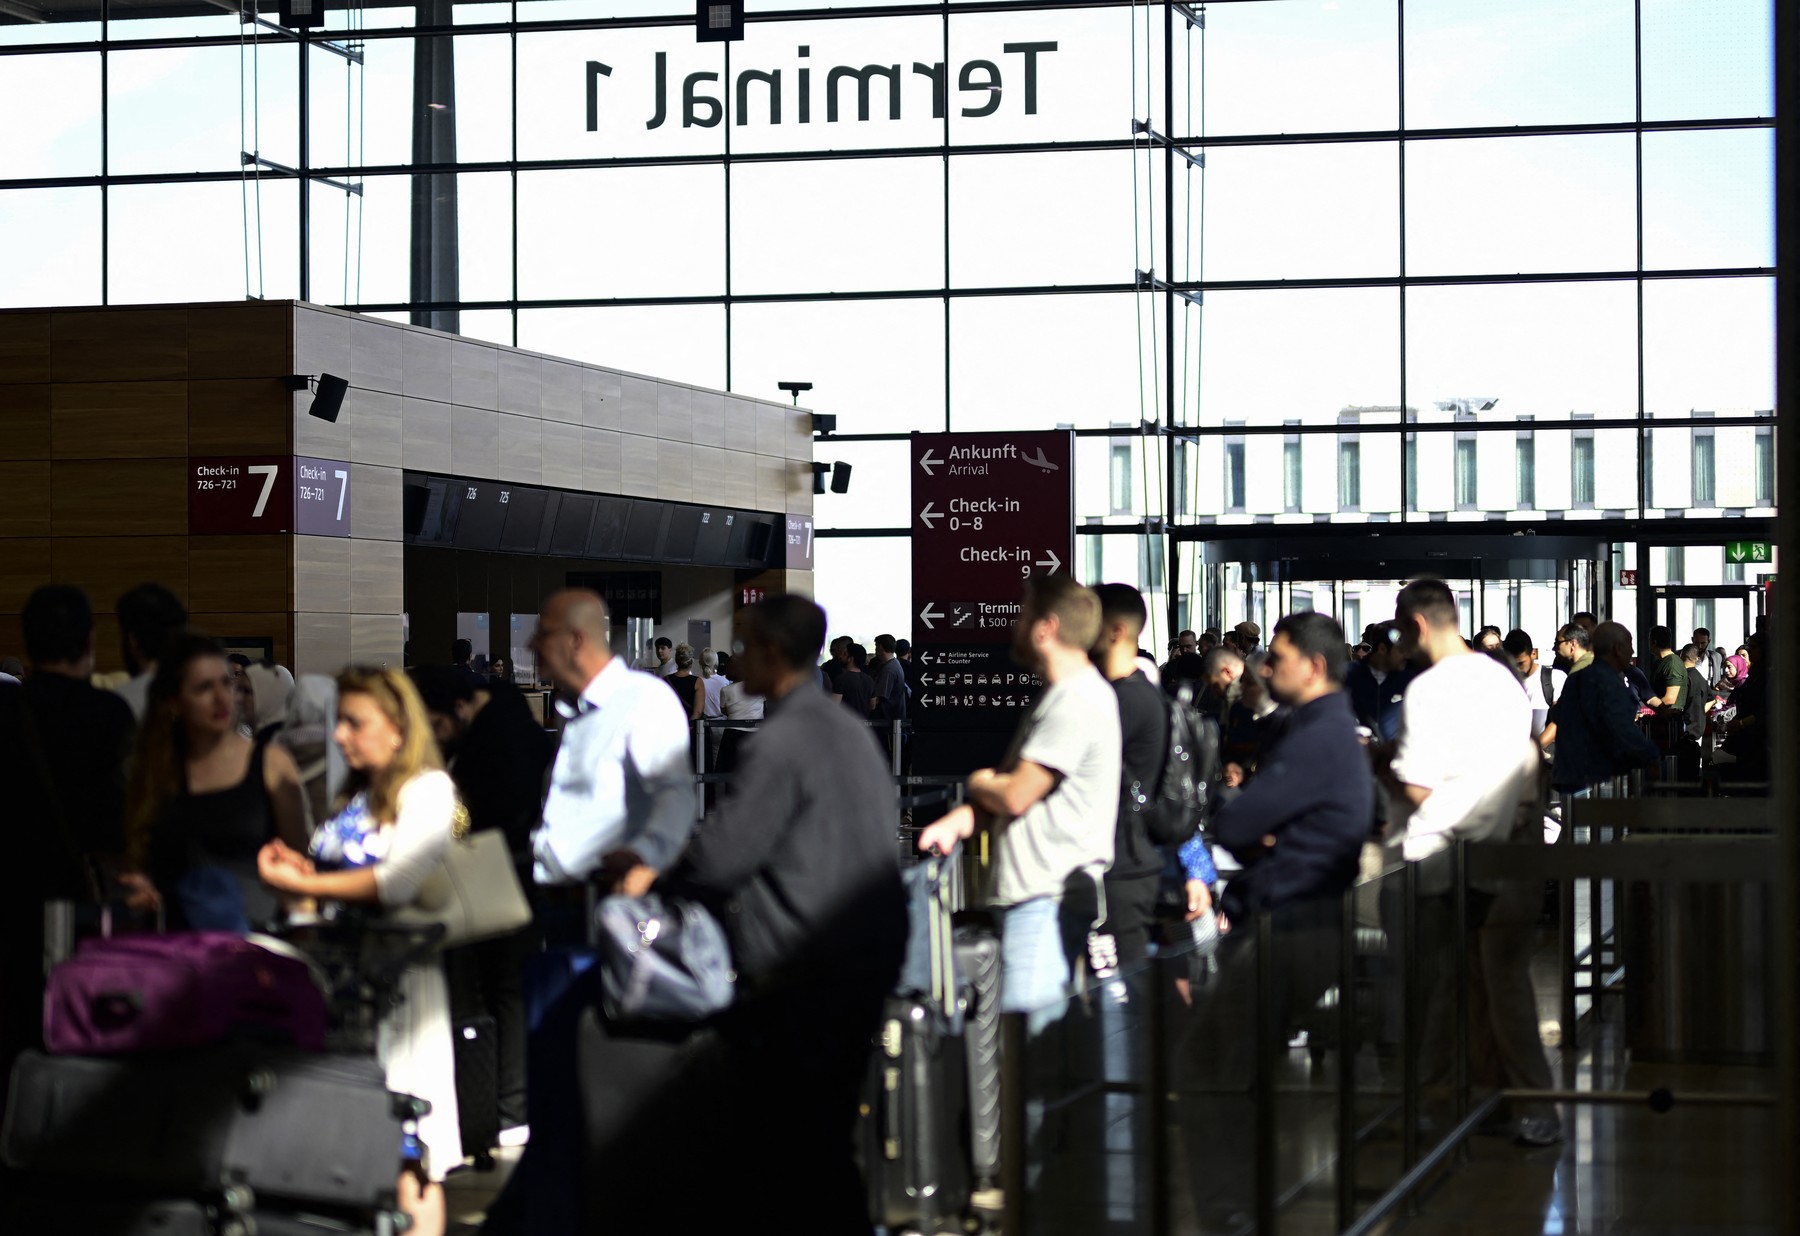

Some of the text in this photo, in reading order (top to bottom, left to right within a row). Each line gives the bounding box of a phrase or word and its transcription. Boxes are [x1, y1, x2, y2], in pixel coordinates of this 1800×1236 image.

[949, 443, 1017, 459] Ankunft
[197, 465, 239, 476] Check-in
[300, 465, 327, 481] Check-in
[949, 463, 989, 475] Arrival
[197, 480, 237, 490] 726–721
[248, 465, 278, 517] 7
[335, 470, 347, 520] 7
[466, 487, 477, 500] 726
[499, 491, 510, 503] 725
[950, 497, 1020, 513] Check-in
[804, 521, 812, 559] 7
[960, 546, 1031, 562] Check-in
[1021, 565, 1031, 579] 9
[978, 602, 1024, 614] Termin
[988, 618, 1007, 627] 500
